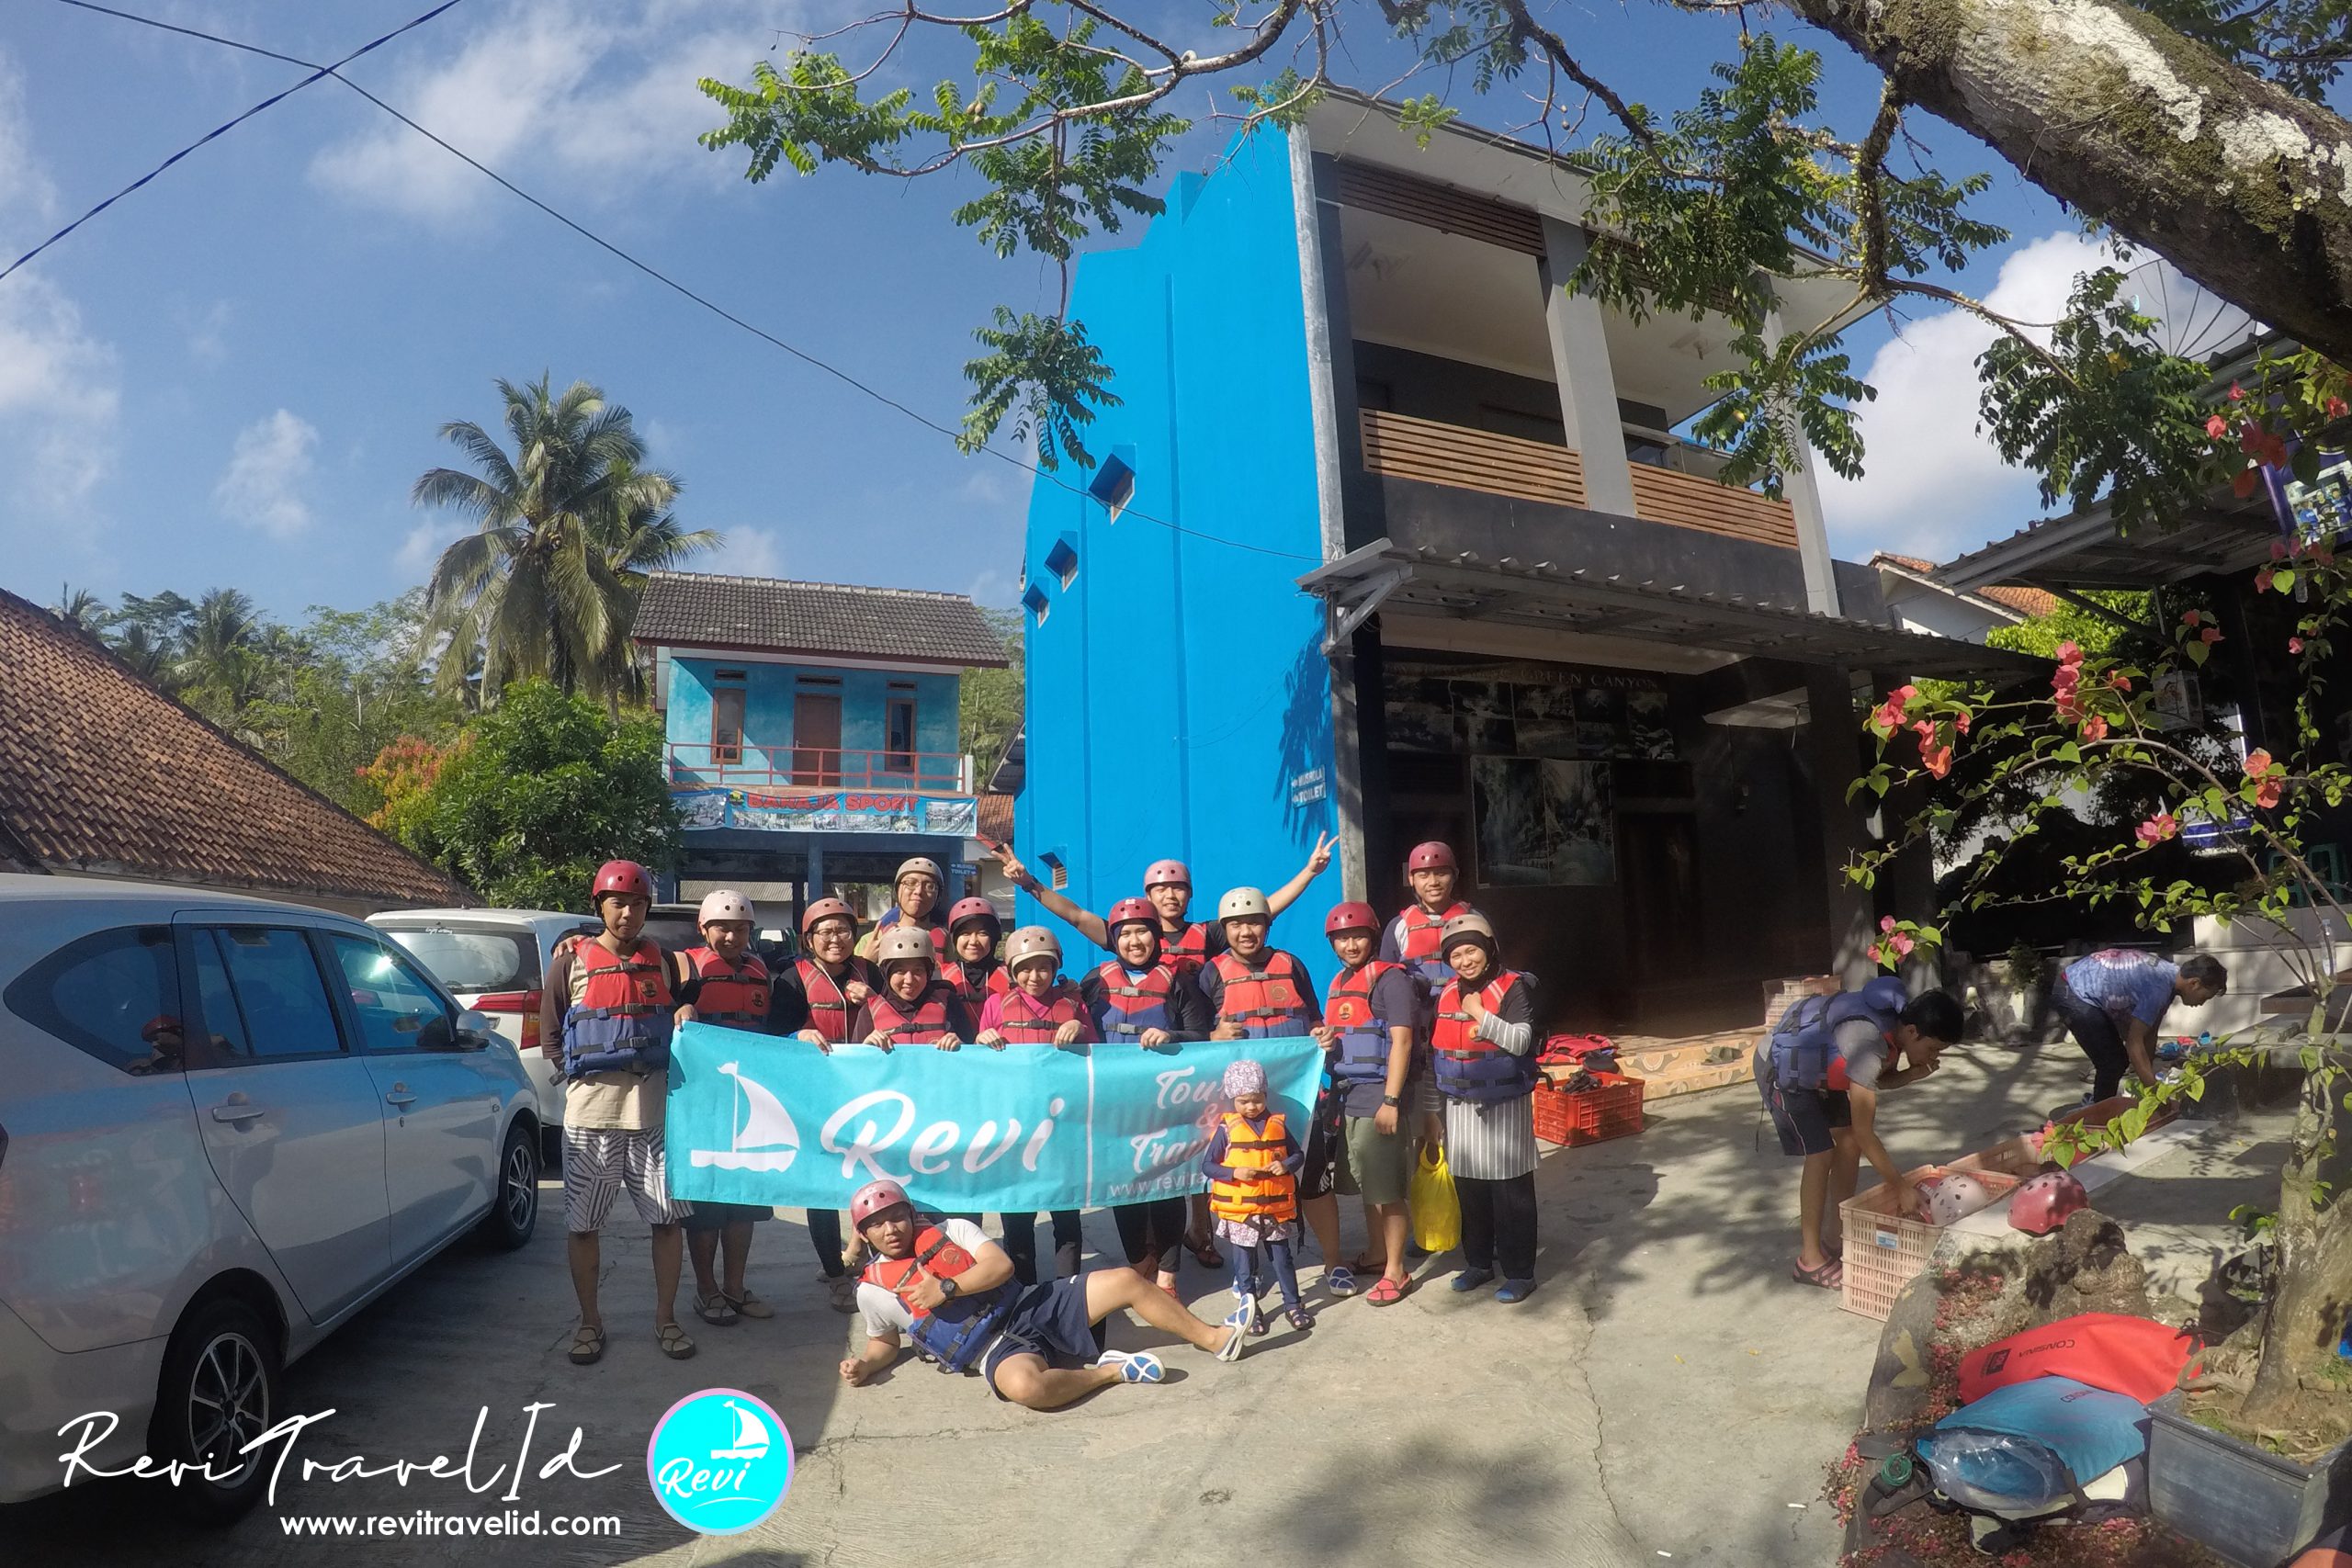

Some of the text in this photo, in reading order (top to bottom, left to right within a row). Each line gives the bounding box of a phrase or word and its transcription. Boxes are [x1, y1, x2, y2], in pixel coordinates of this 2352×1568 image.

[1590, 674, 1658, 690] CANYON
[1298, 784, 1324, 803] TOILET
[845, 795, 920, 813] SPORT
[820, 1089, 1065, 1188] Revi
